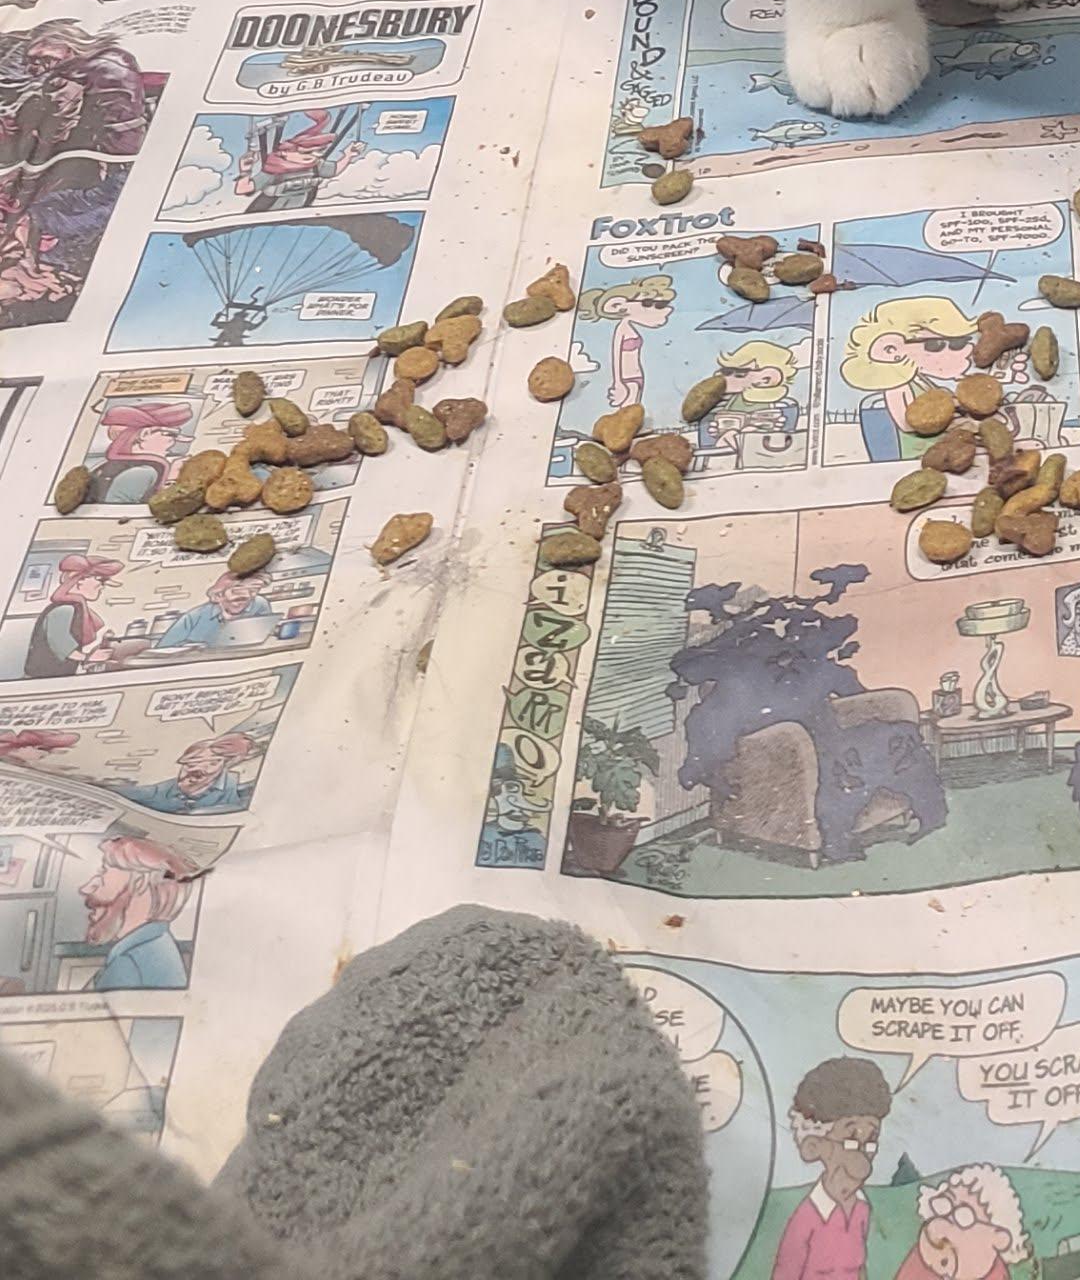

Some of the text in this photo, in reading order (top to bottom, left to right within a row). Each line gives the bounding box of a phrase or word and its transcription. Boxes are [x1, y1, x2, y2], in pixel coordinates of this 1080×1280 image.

[230, 4, 476, 49] DOONESBURY
[630, 60, 654, 81] &
[267, 71, 409, 96] by Trudeau
[620, 79, 673, 109] GAGGED
[591, 206, 736, 240] FoxTrot
[940, 218, 993, 229] SPF-100,
[971, 209, 1024, 218] BROUGHT
[940, 223, 1052, 238] AND MY PERSONAL
[611, 246, 630, 256] DID
[635, 243, 658, 253] YOU
[662, 240, 692, 250] PACK
[940, 236, 983, 247] GO-TO,
[626, 245, 700, 263] SUNSCREEN?
[324, 390, 350, 398] THAT
[871, 992, 1025, 1020] MAYBE YOU CAN
[872, 1019, 1024, 1042] SCRAPE IT OFF.
[980, 1061, 1030, 1084] YOU
[1007, 1088, 1037, 1110] IT
